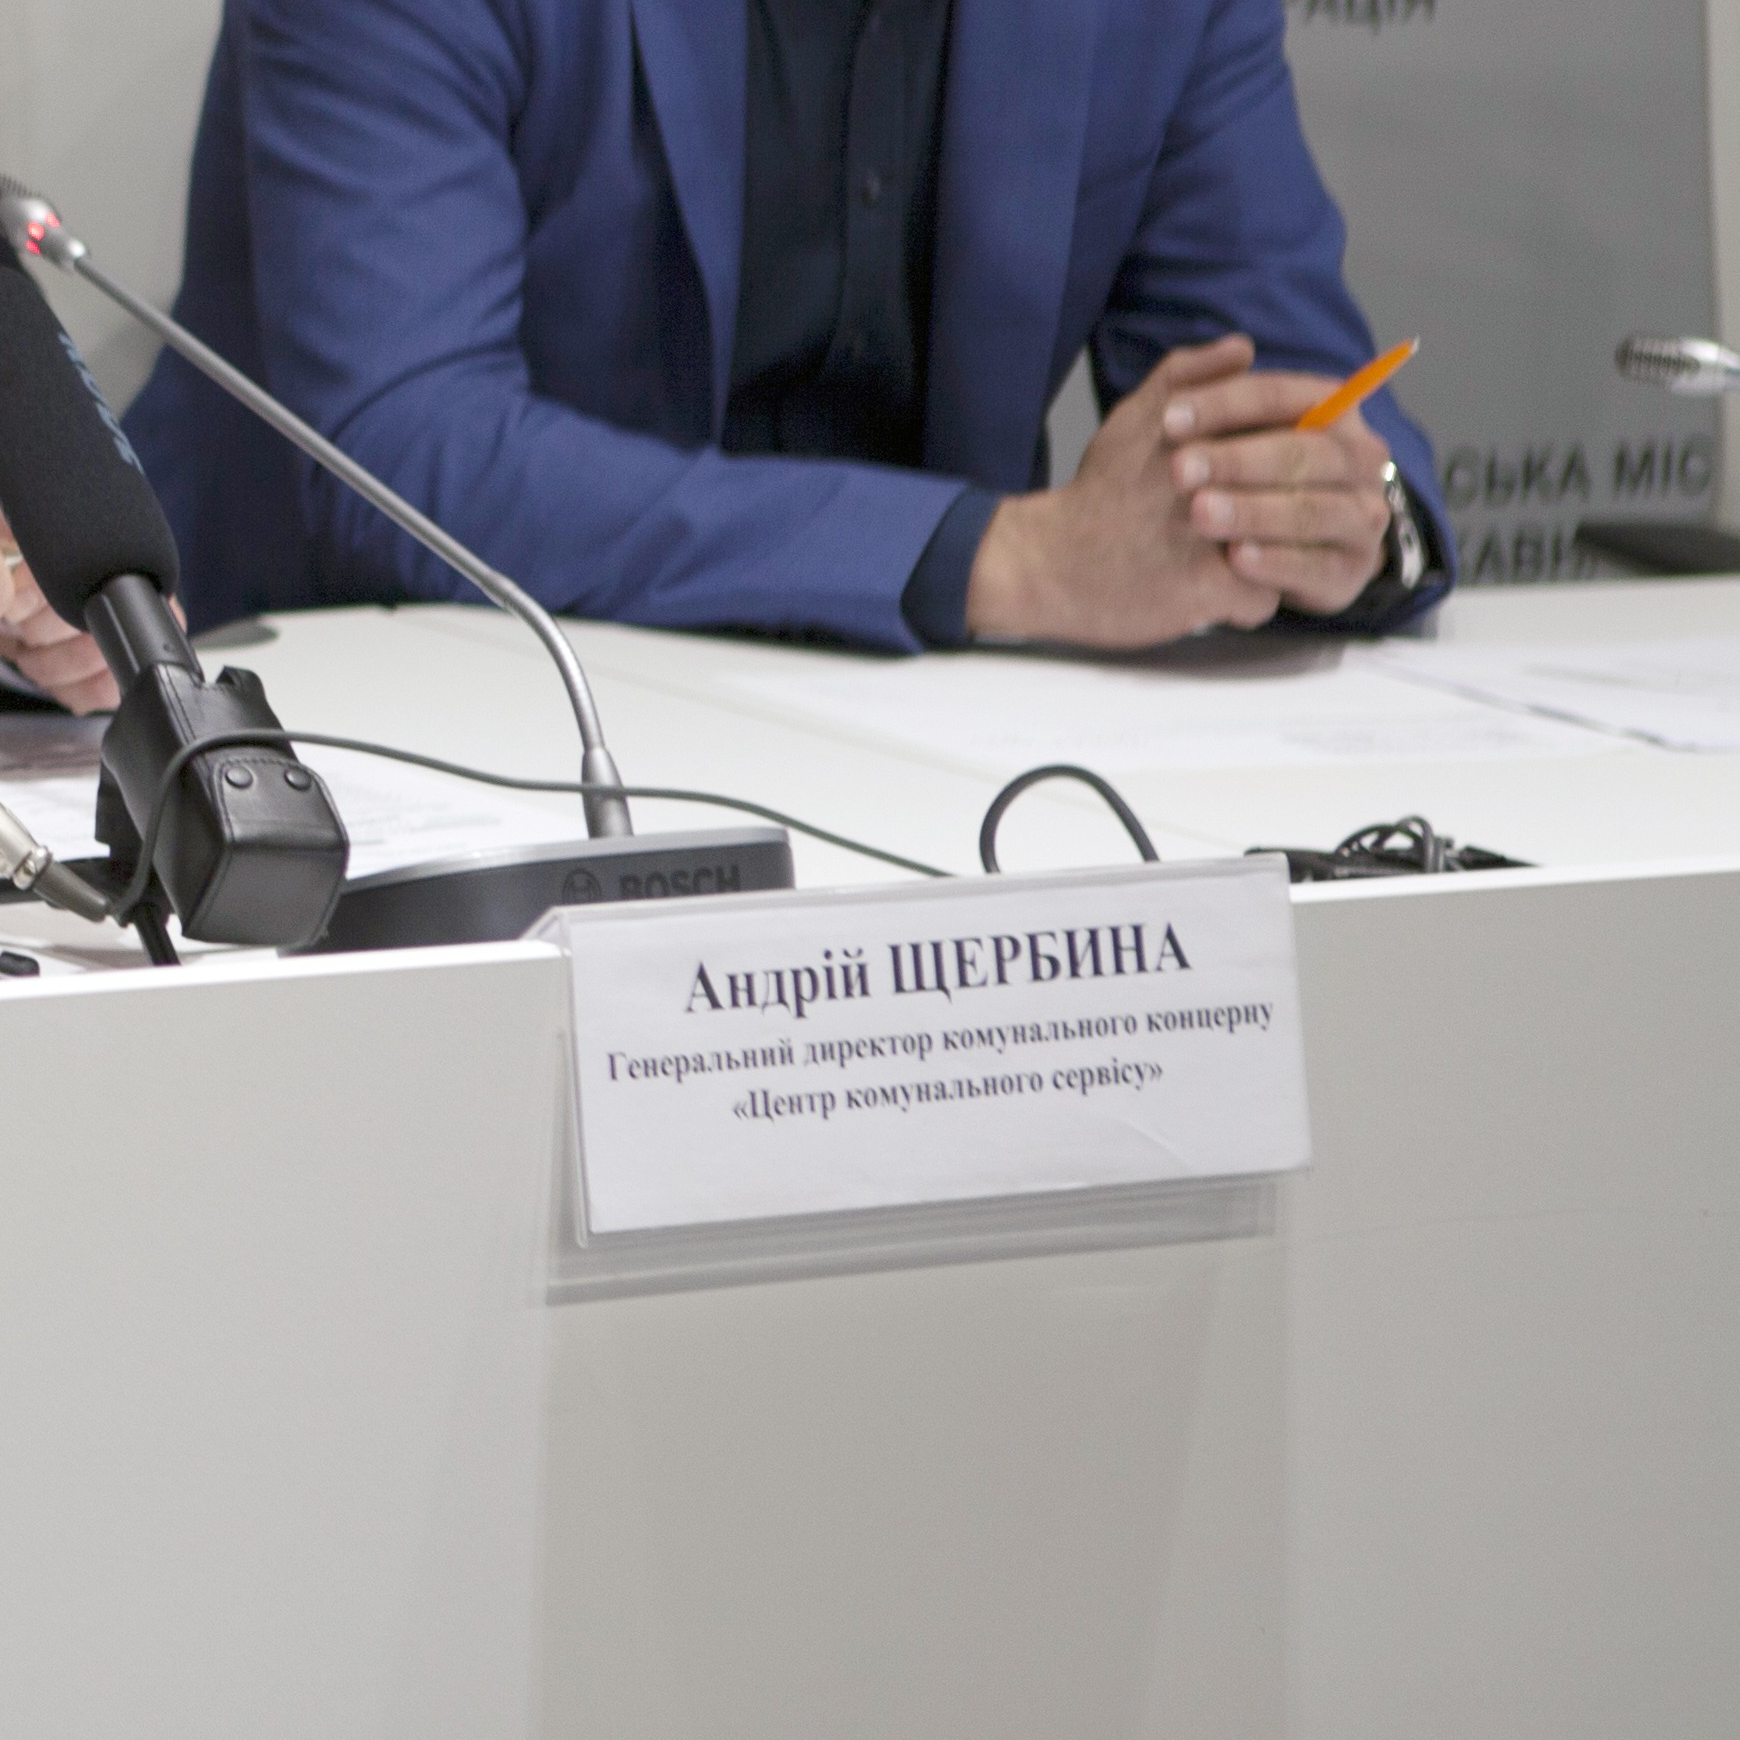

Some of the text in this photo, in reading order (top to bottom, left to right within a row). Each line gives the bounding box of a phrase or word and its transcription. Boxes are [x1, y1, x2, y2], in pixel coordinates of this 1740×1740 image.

[620, 864, 741, 901] BOSCH
[683, 922, 1193, 1018] Андрій ЩЕРБИНА
[606, 1001, 1274, 1086] Генеральний директор комунального концерну
[731, 1058, 1165, 1122] «Центр комунального сервісу»
